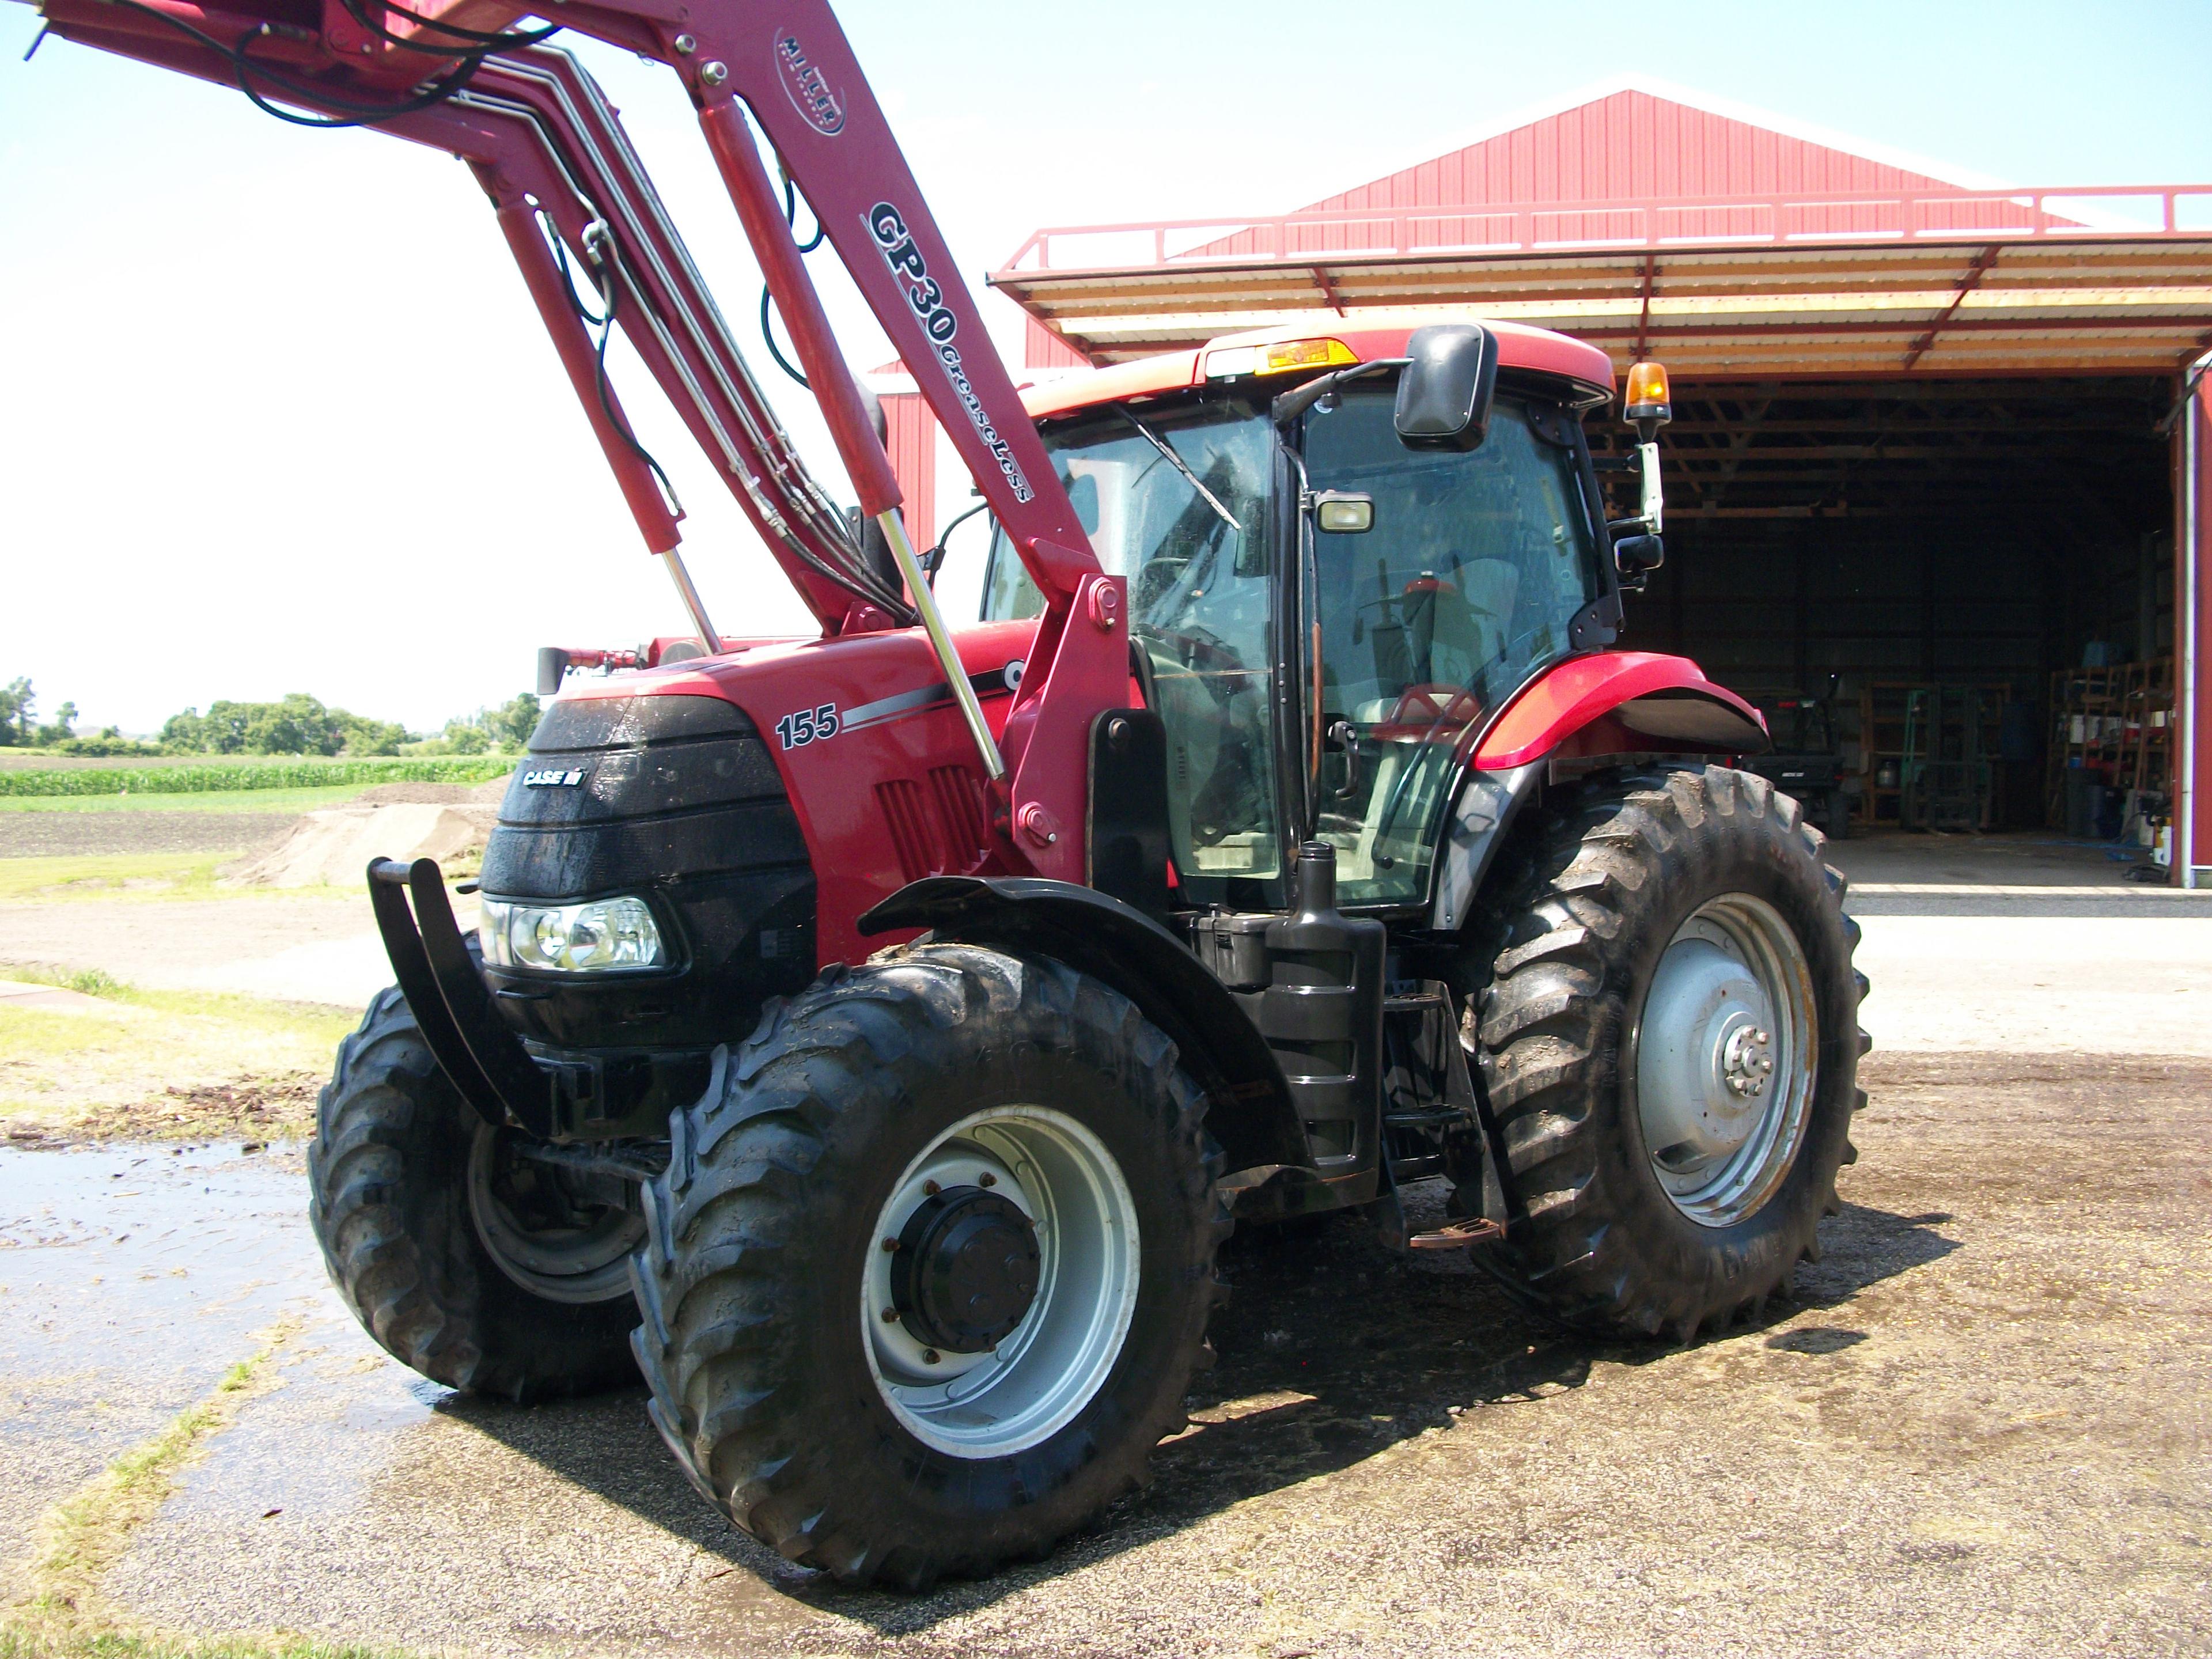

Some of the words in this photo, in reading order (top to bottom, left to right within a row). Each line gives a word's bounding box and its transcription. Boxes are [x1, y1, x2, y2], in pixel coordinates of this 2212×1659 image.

[783, 36, 835, 124] MILLER
[869, 202, 957, 346] GP30
[775, 702, 839, 751] 155
[522, 770, 565, 785] CASE
